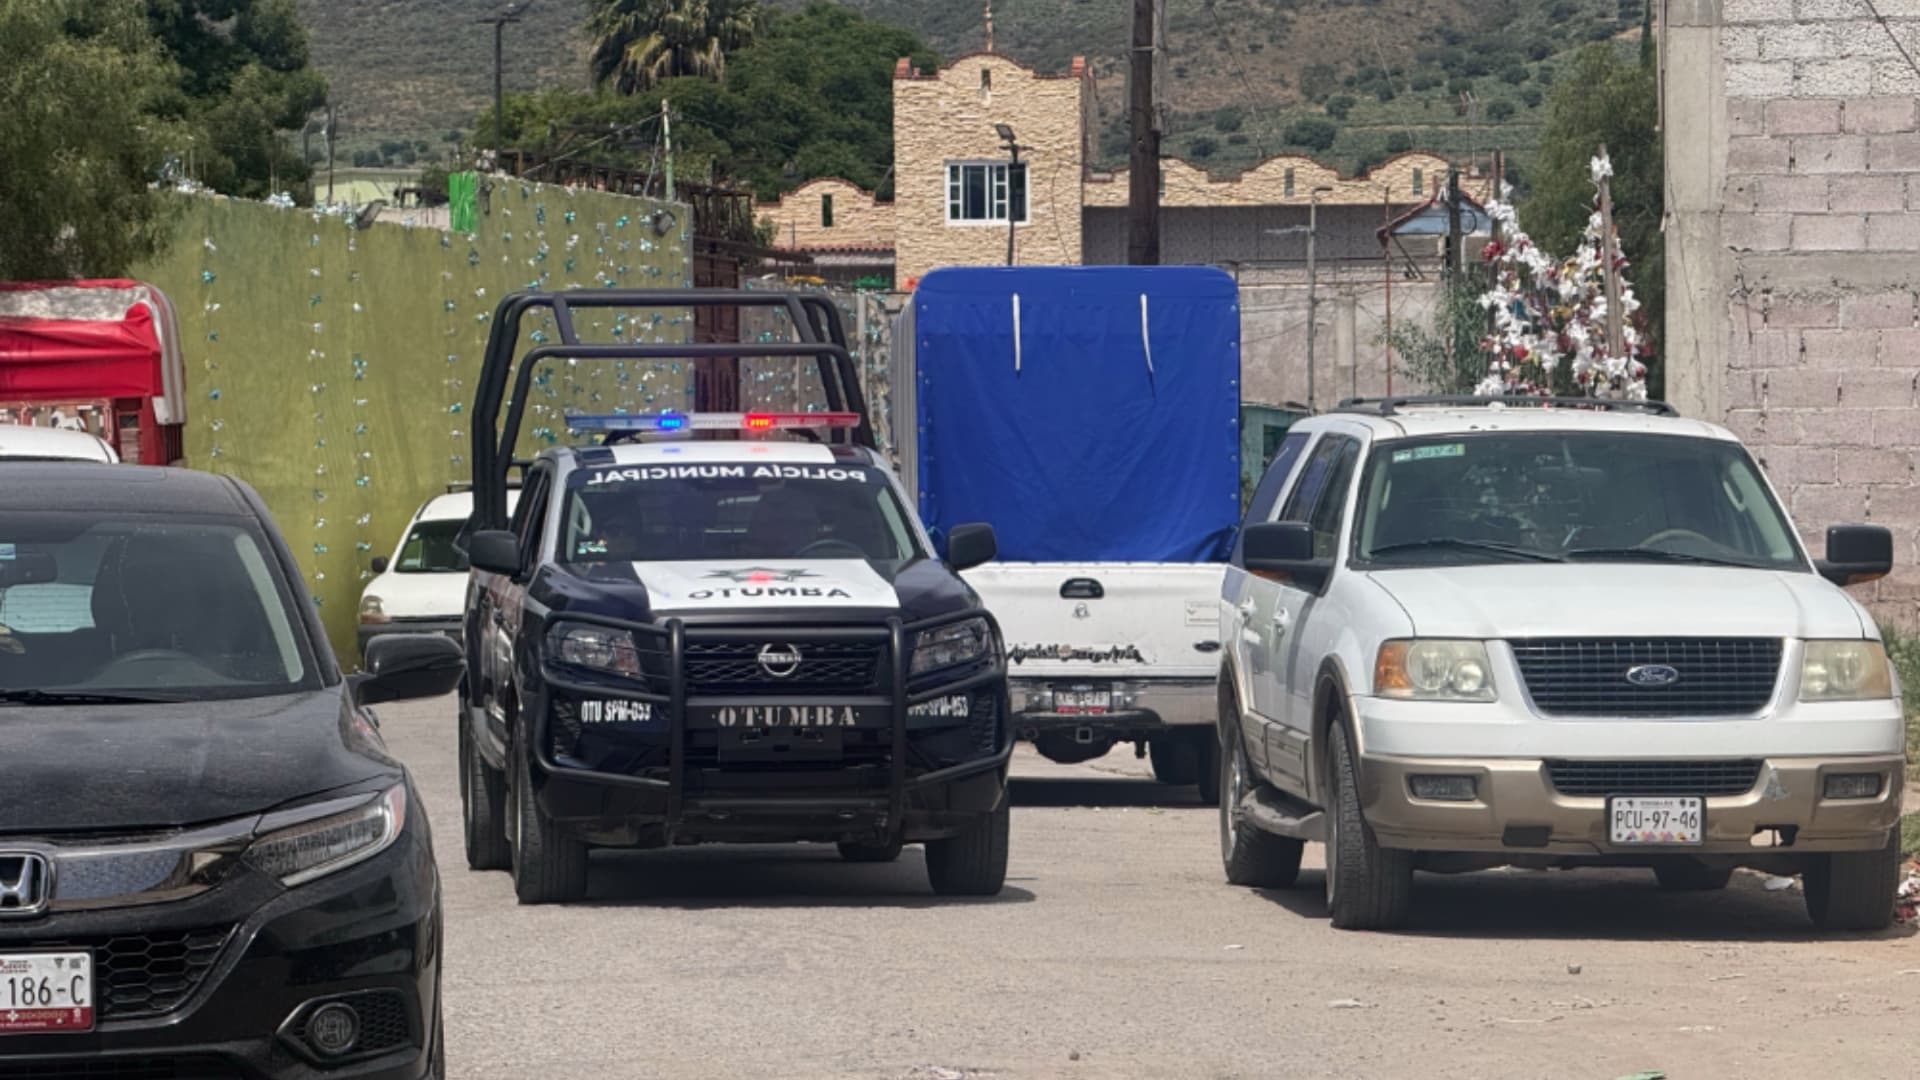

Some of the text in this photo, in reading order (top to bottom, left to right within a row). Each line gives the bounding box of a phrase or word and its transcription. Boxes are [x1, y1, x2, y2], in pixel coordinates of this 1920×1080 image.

[688, 587, 852, 599] OTUMBA
[581, 700, 602, 722] OTU
[718, 706, 856, 726] OTUMBA
[1615, 810, 1698, 829] PCU-97-46
[0, 975, 84, 1006] 186-C
